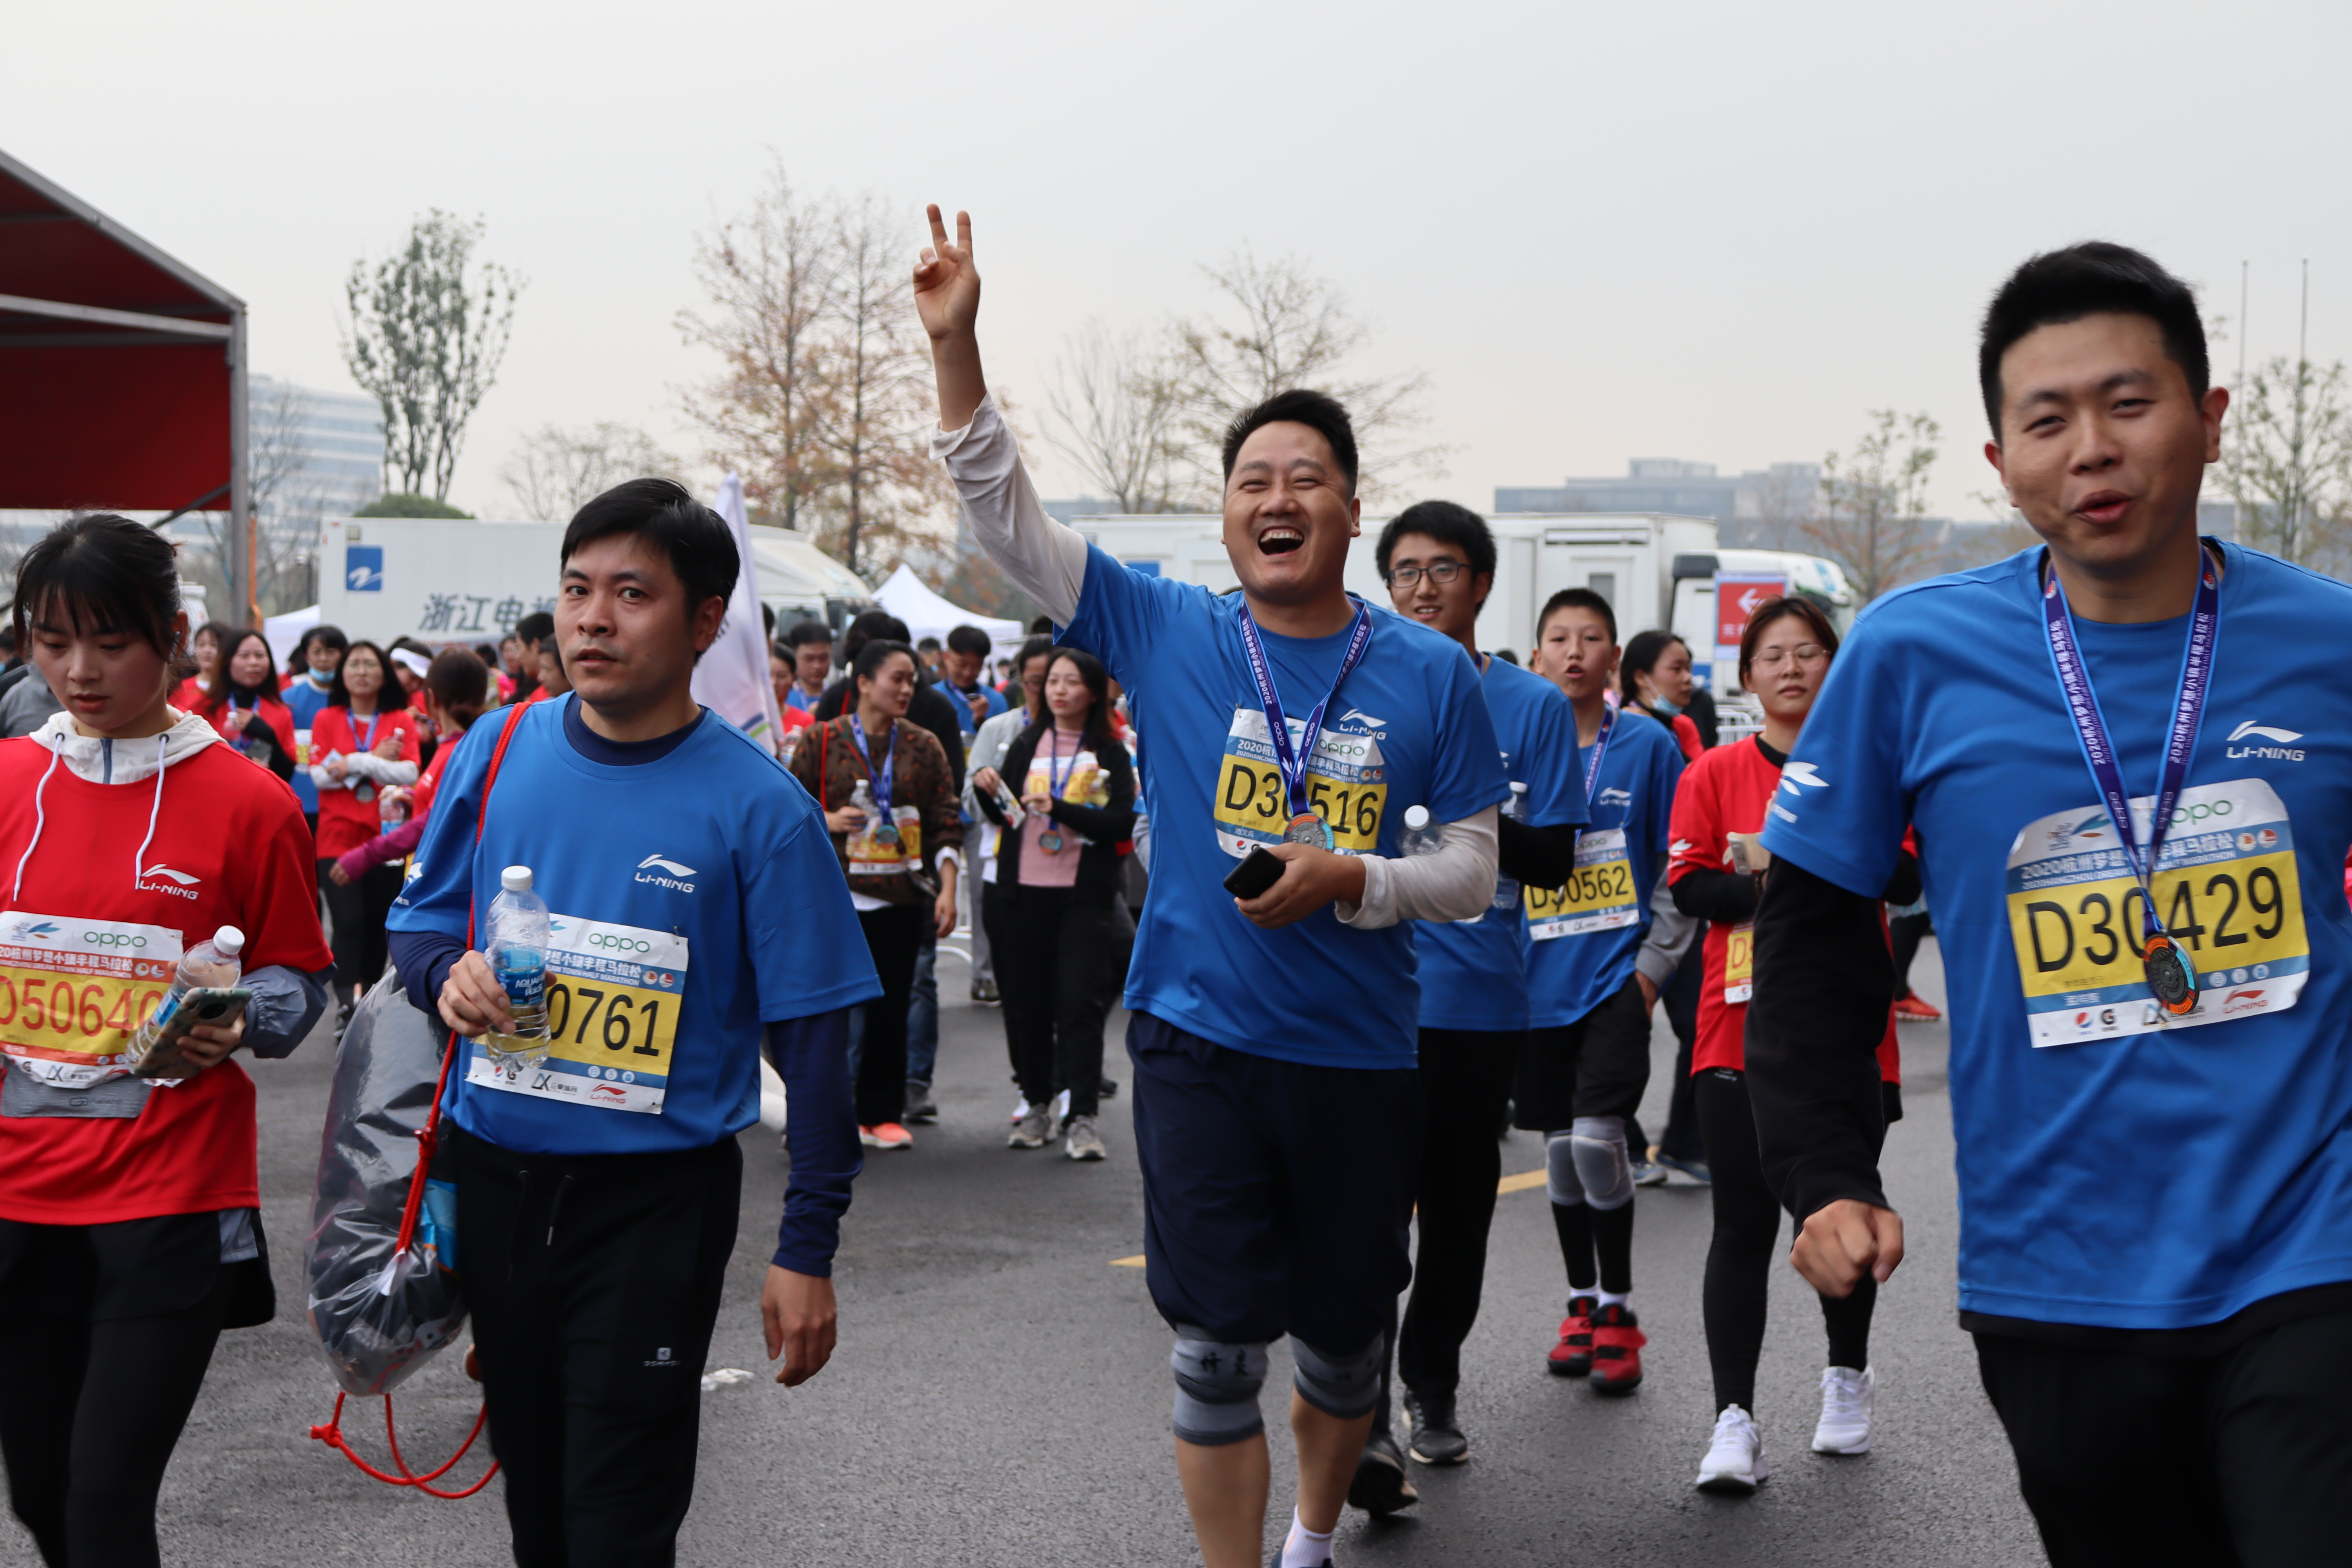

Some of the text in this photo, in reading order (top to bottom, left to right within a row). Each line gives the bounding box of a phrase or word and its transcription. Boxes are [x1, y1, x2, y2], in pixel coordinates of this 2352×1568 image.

[1274, 721, 1284, 746] oppo
[1305, 722, 1315, 746] oppo
[1319, 739, 1365, 756] oppo
[2226, 746, 2305, 761] LI-NING
[1316, 768, 1329, 776] HALF
[1329, 771, 1358, 782] MARATHON
[139, 880, 199, 900] LI-NING
[635, 872, 695, 893] LI-NING
[84, 931, 147, 948] oppo
[589, 933, 650, 953] oppo
